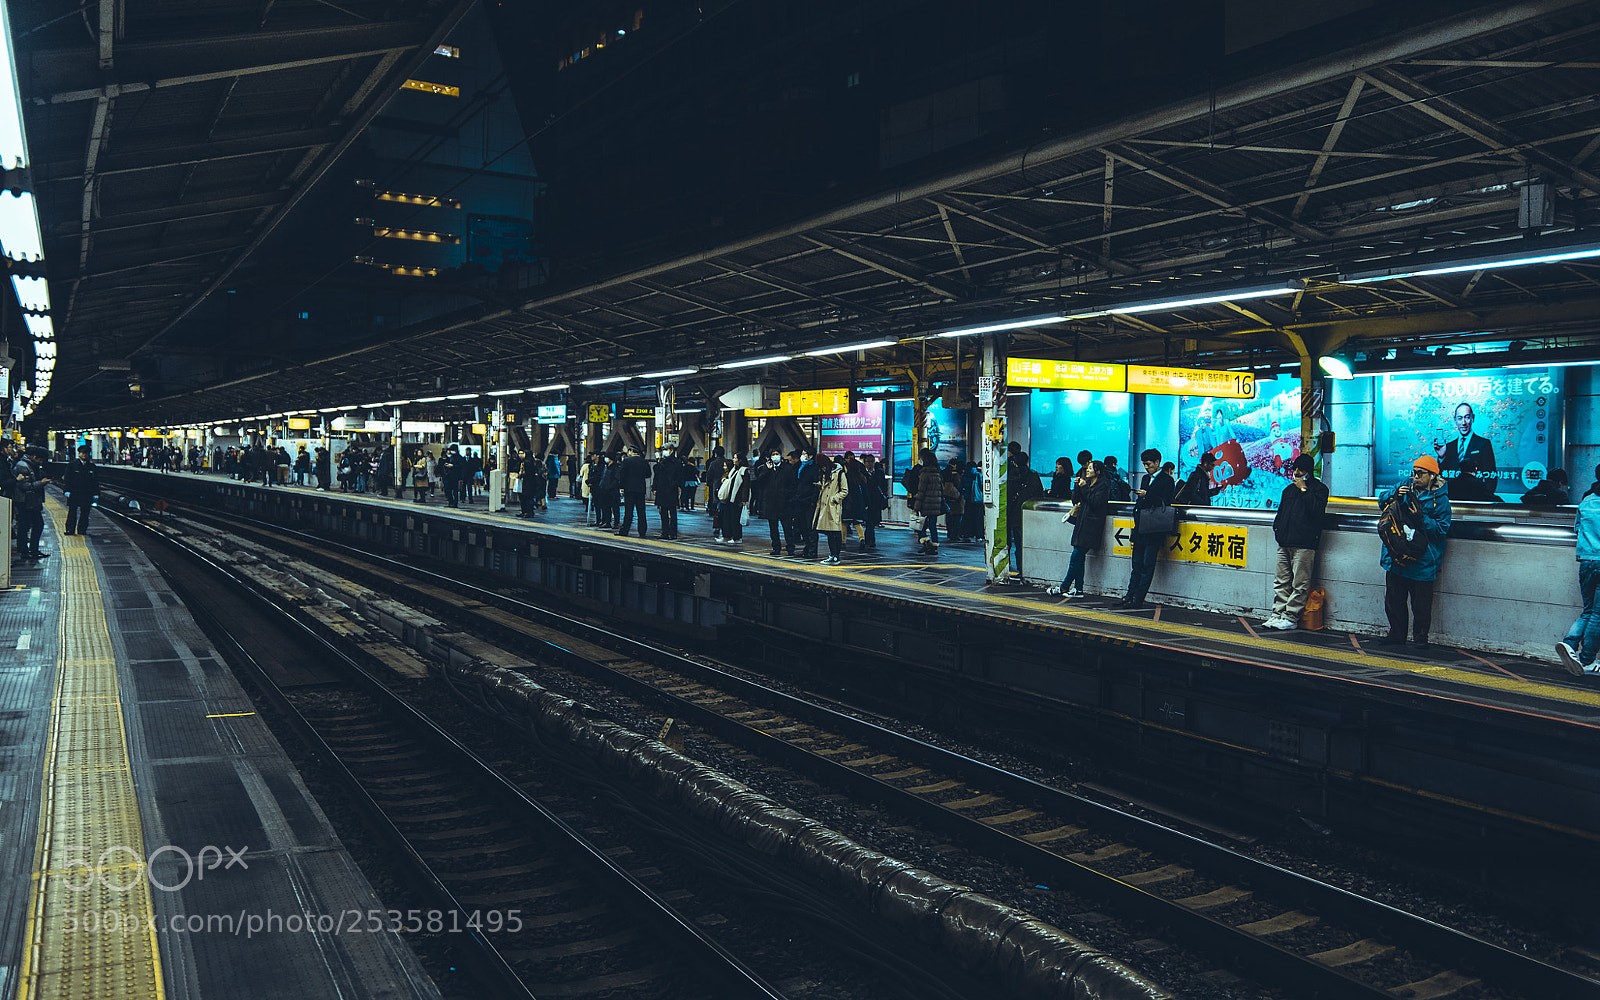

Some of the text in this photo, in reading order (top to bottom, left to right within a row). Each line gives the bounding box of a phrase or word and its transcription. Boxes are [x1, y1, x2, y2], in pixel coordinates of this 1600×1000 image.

[1011, 361, 1042, 374] 山手線
[1234, 375, 1252, 395] 16
[1169, 531, 1246, 560] スタ新宿
